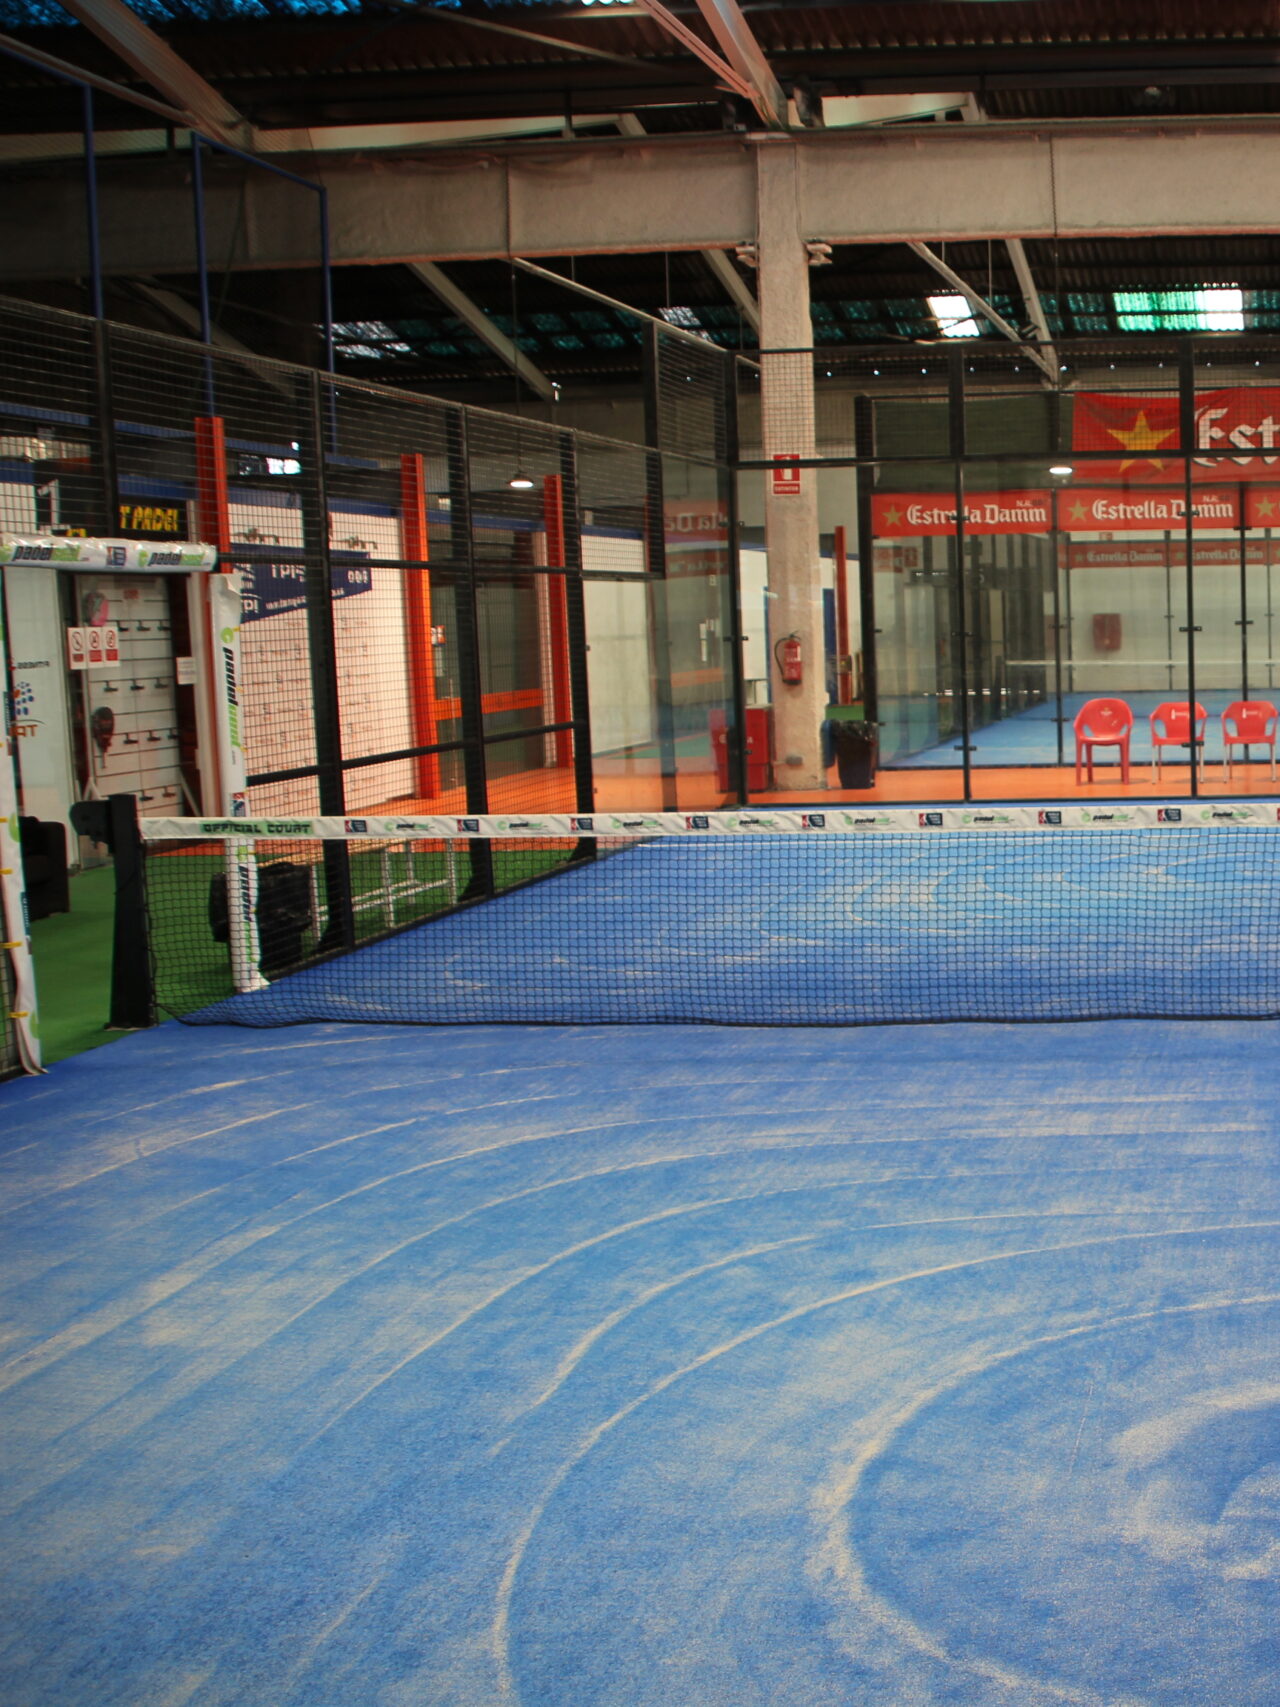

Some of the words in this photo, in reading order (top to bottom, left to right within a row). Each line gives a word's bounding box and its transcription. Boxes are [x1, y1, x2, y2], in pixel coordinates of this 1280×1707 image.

[907, 503, 982, 526] Estrela
[983, 503, 1047, 525] Damm
[1092, 498, 1167, 521] Estrella
[1188, 549, 1228, 561] strella
[1229, 547, 1263, 560] Dmm
[203, 822, 261, 833] OFFICIAL
[266, 823, 312, 834] COURT
